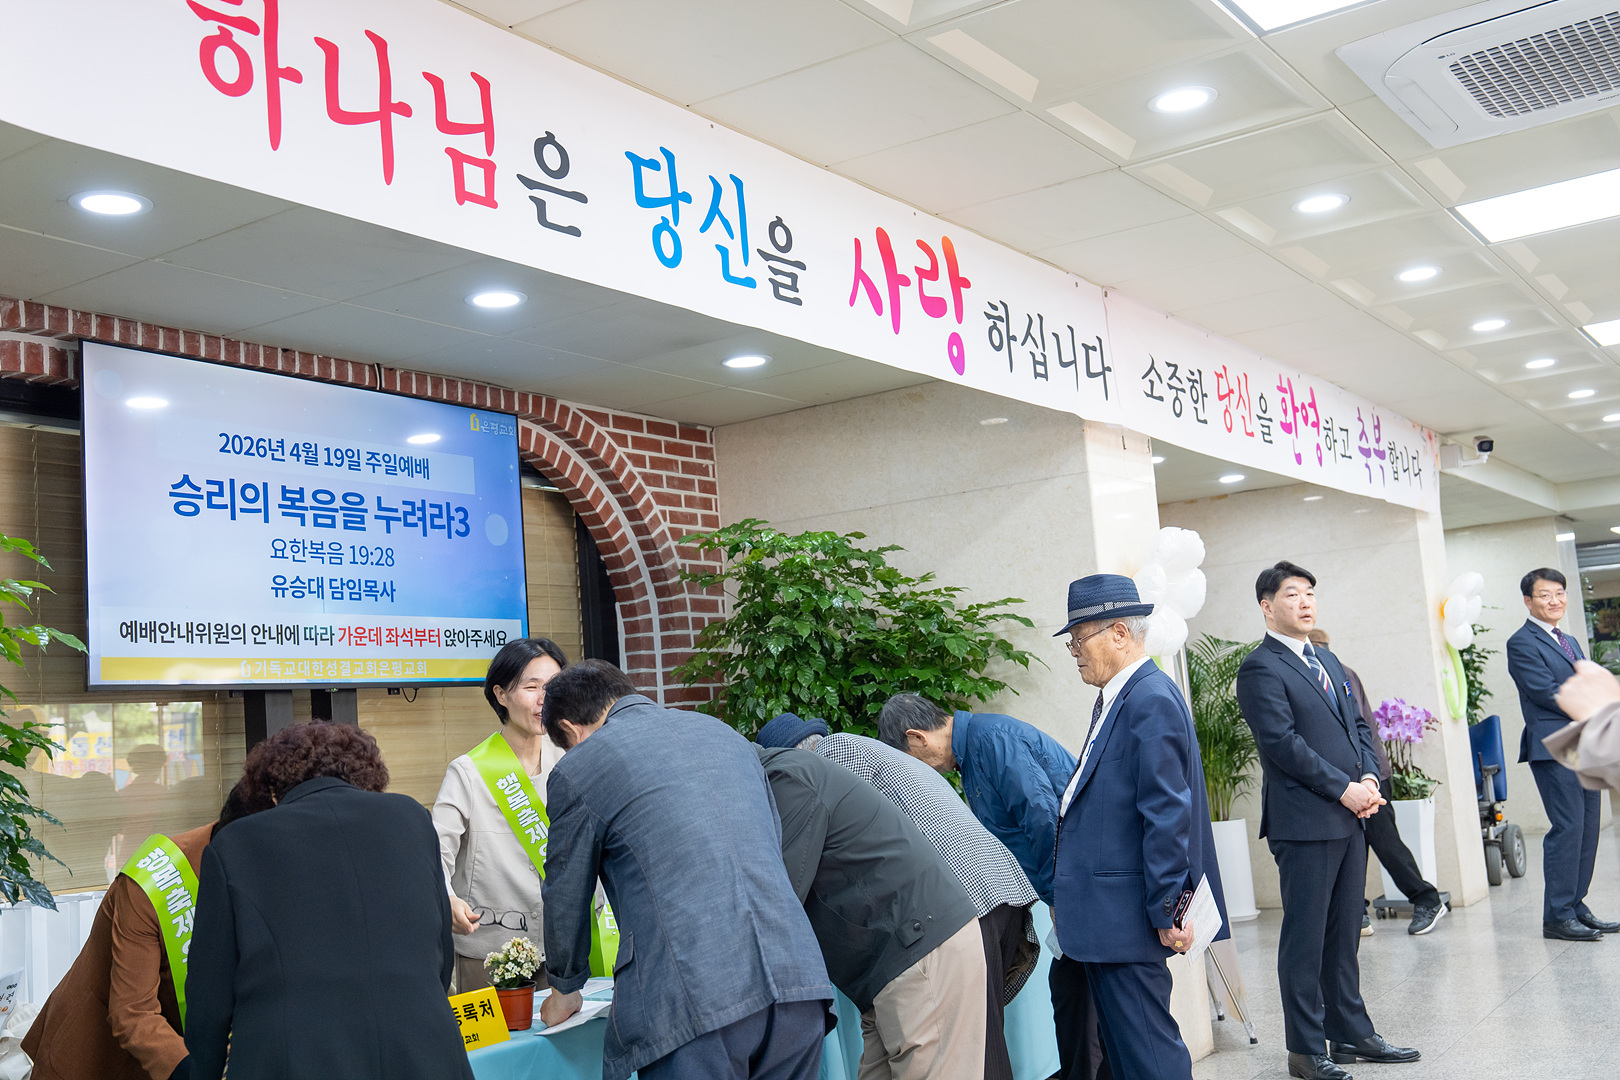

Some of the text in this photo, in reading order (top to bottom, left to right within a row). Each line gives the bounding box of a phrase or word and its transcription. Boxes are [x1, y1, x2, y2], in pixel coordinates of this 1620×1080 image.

[186, 0, 589, 237] 하나님은
[624, 146, 807, 306] 당신을
[480, 420, 517, 437] 은평교회
[1141, 353, 1422, 490] 소중한 당신을 환영하고 축복합니다
[218, 432, 430, 480] 2026년 4월 19일 주일예배
[169, 473, 471, 540] 승리의 복음을 누려라3
[270, 538, 395, 567] 요한복음 19:28
[270, 575, 396, 603] 유승대 담임목사
[119, 620, 508, 648] 예배안내위원의 안내에 따라 가운데 좌석부터 앉아주세요
[254, 660, 427, 677] 기독교대한성결교회은평교회
[496, 771, 548, 844] 행복축제
[463, 1033, 480, 1044] 교회
